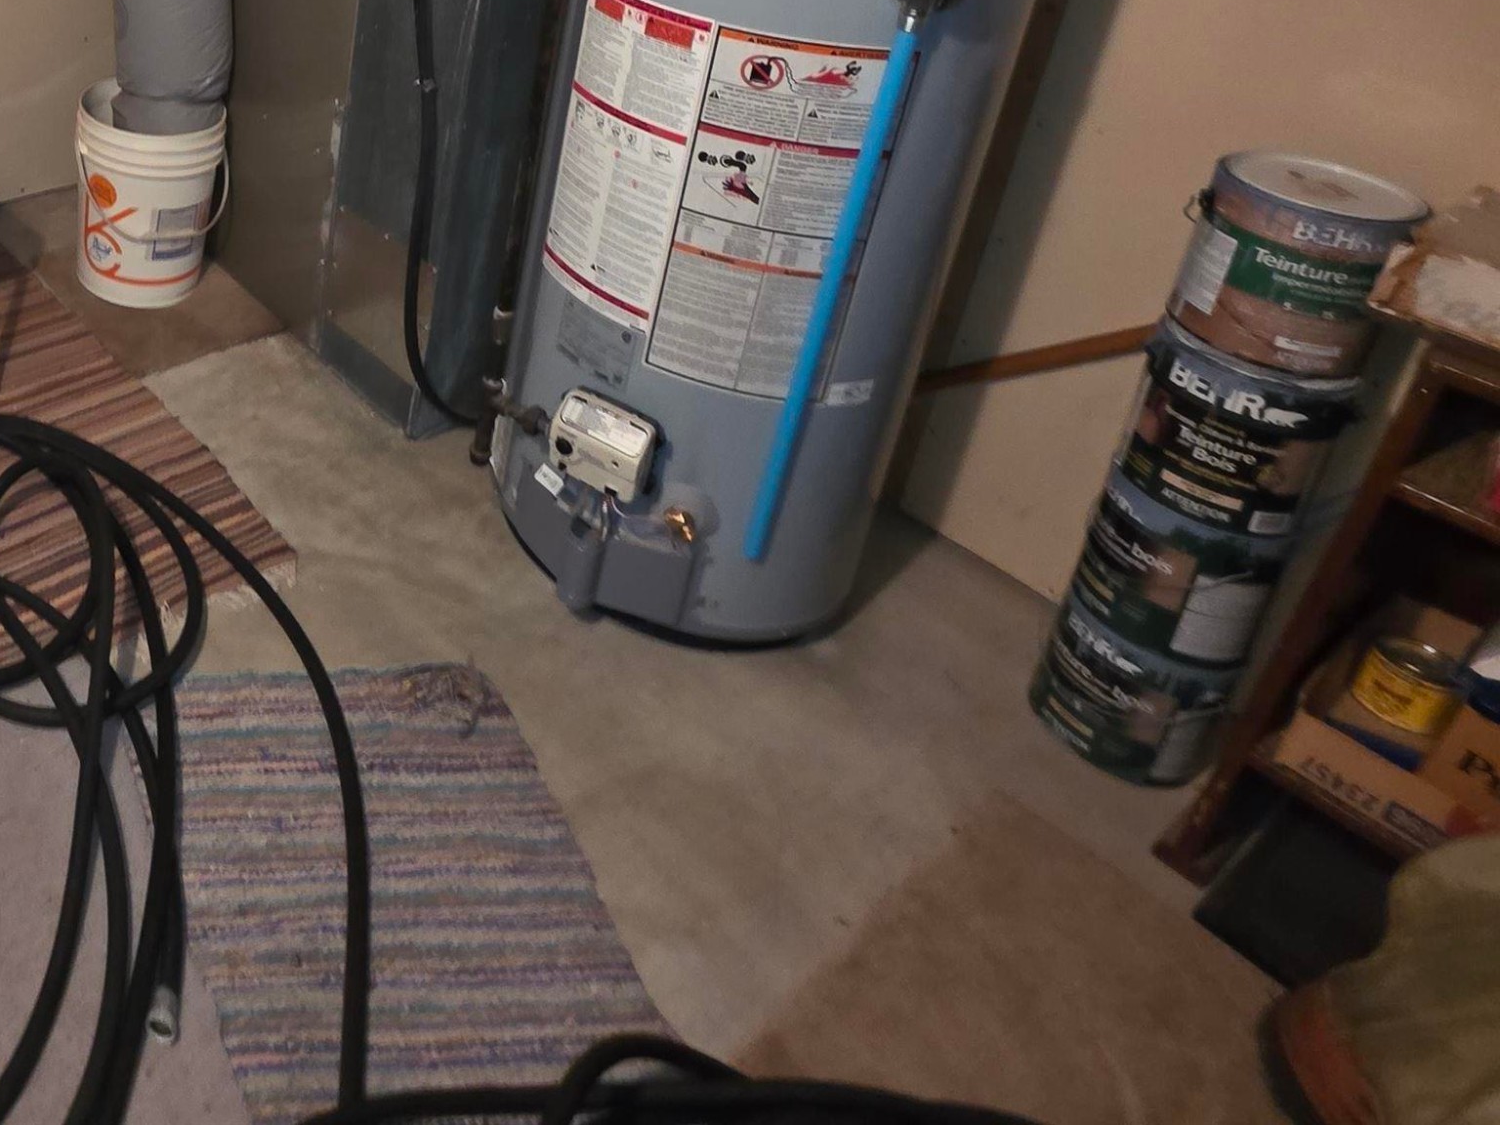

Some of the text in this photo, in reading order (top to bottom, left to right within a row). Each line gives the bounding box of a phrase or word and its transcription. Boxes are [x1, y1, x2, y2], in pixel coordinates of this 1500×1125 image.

[756, 36, 800, 50] WARNING
[780, 142, 820, 156] DANGER
[1255, 246, 1349, 284] Teinture
[1178, 424, 1258, 466] Teinture
[1192, 446, 1238, 474] Bois
[1130, 542, 1174, 575] bois
